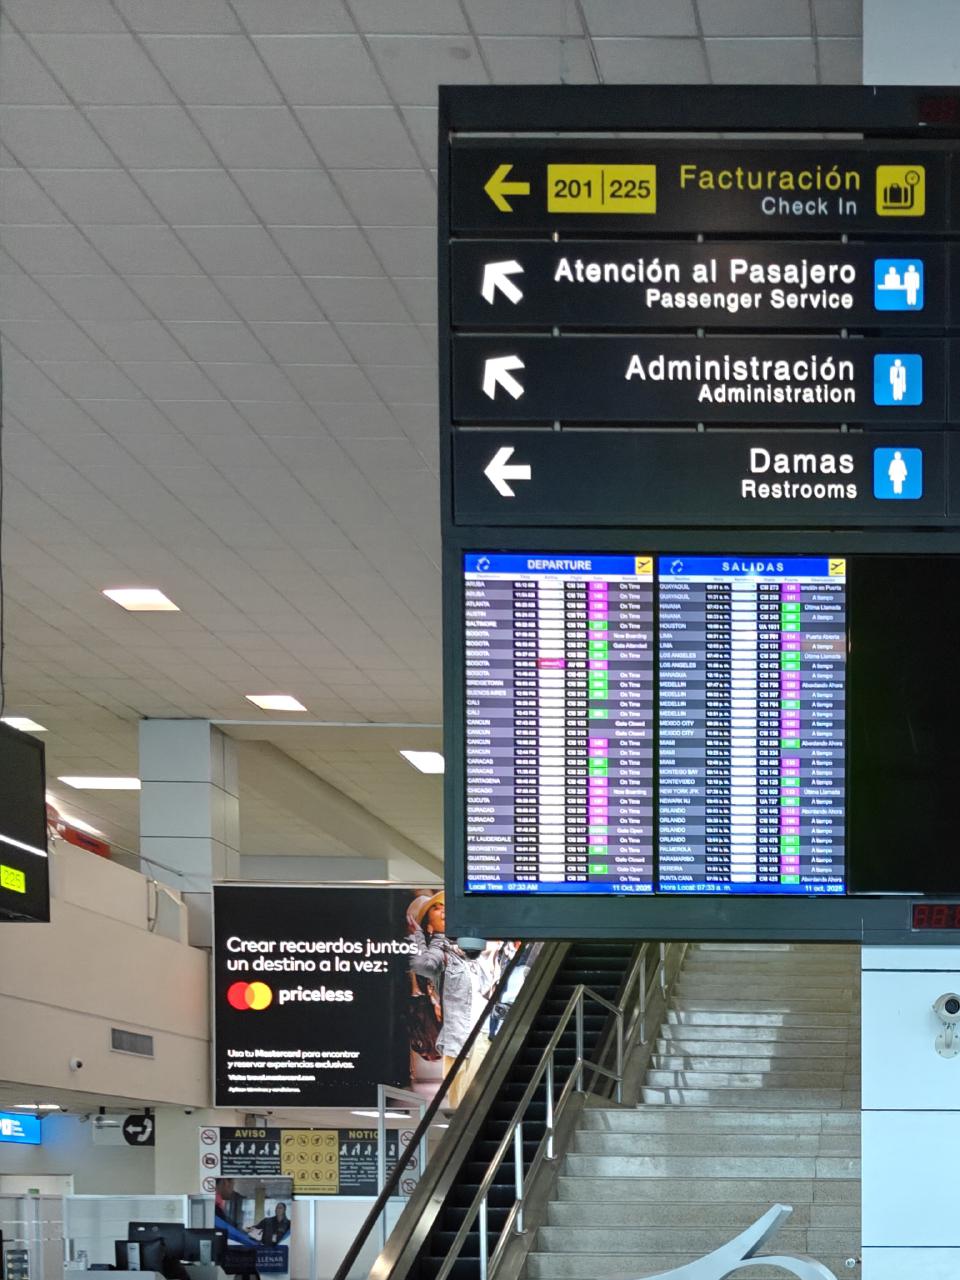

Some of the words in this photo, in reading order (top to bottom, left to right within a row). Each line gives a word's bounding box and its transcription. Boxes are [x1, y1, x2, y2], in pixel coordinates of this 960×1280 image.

[680, 165, 861, 191] Facturación
[554, 180, 592, 199] 201
[609, 181, 651, 200] 225
[761, 197, 828, 216] Check
[839, 197, 857, 216] In
[555, 258, 681, 283] Atención
[694, 259, 717, 283] al
[730, 259, 856, 290] Pasajero
[646, 289, 761, 313] Passenger
[771, 289, 853, 309] Service
[625, 355, 855, 381] Administración
[698, 384, 856, 403] Administration
[750, 448, 854, 474] Damas
[741, 479, 857, 499] Restrooms
[527, 560, 591, 570] DEPARTURE
[722, 562, 783, 571] SALIDAS
[227, 936, 276, 953] Crear
[280, 937, 363, 954] recuerdos
[366, 938, 422, 957] juntos,
[227, 959, 249, 971] un
[252, 956, 316, 972] destino
[319, 960, 331, 972] a
[335, 956, 350, 972] la
[354, 960, 388, 972] vez:
[279, 986, 354, 1005] priceless
[227, 1049, 244, 1058] Usa
[245, 1050, 254, 1058] tu
[255, 1049, 301, 1058] Mastercard
[302, 1051, 320, 1059] para
[227, 1061, 233, 1069] y
[267, 1061, 314, 1070] experiencias
[315, 1060, 355, 1069] exclusivas.
[235, 1129, 266, 1138] AVISO
